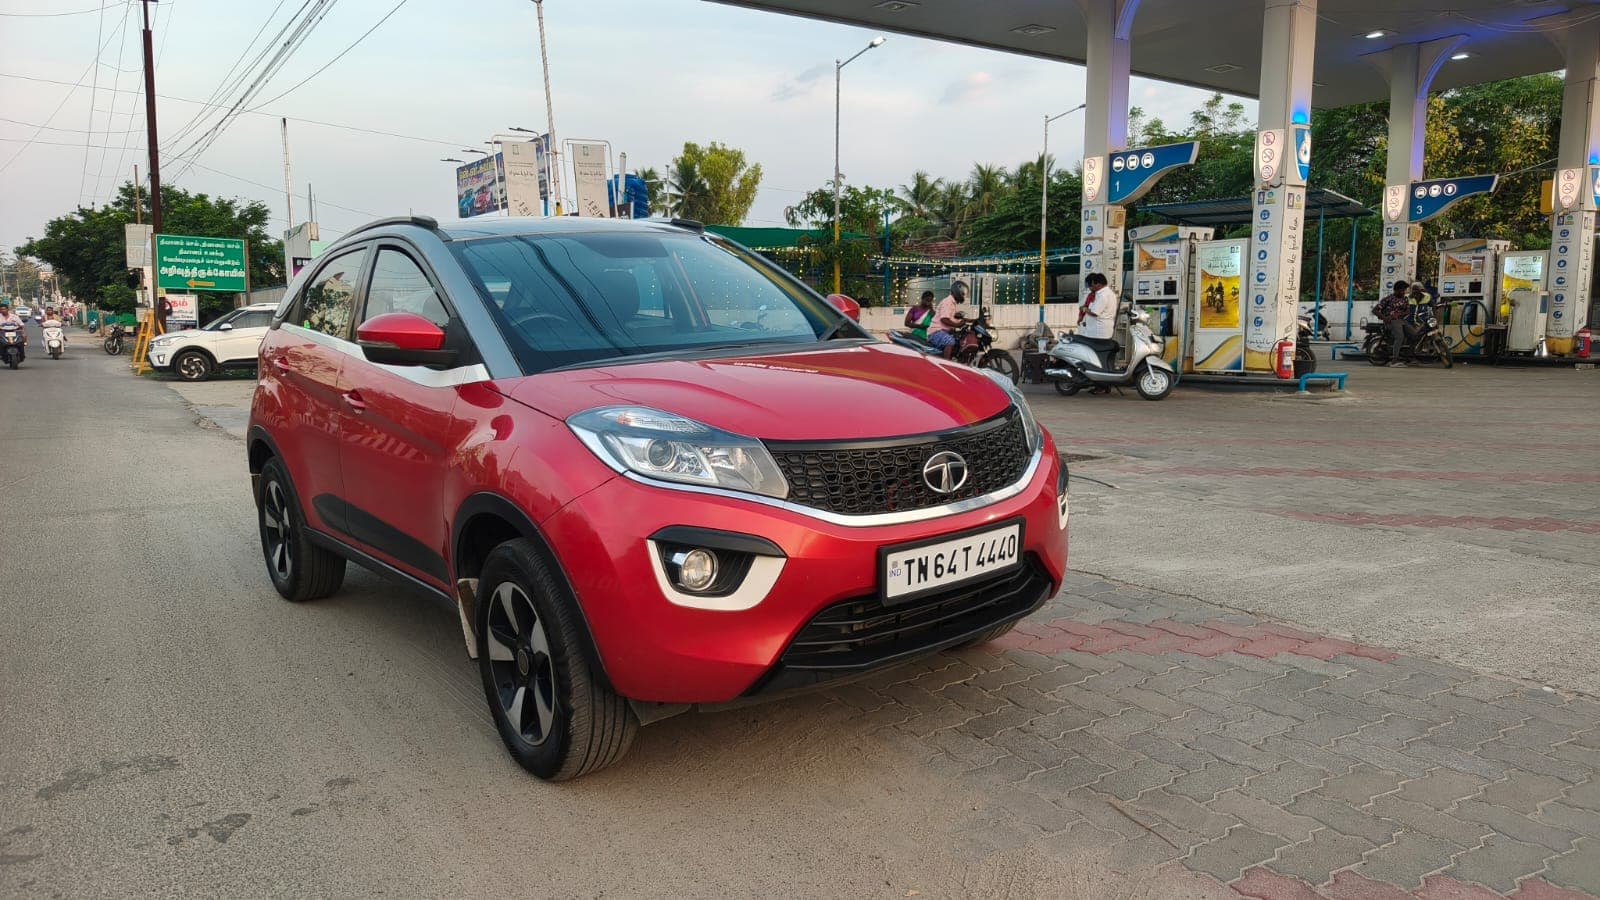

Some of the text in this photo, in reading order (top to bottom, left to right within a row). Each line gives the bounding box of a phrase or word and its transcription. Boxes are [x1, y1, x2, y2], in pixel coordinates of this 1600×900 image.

[1115, 181, 1120, 192] 1
[1416, 205, 1423, 215] 3
[904, 534, 1016, 586] TN 64 T 4440
